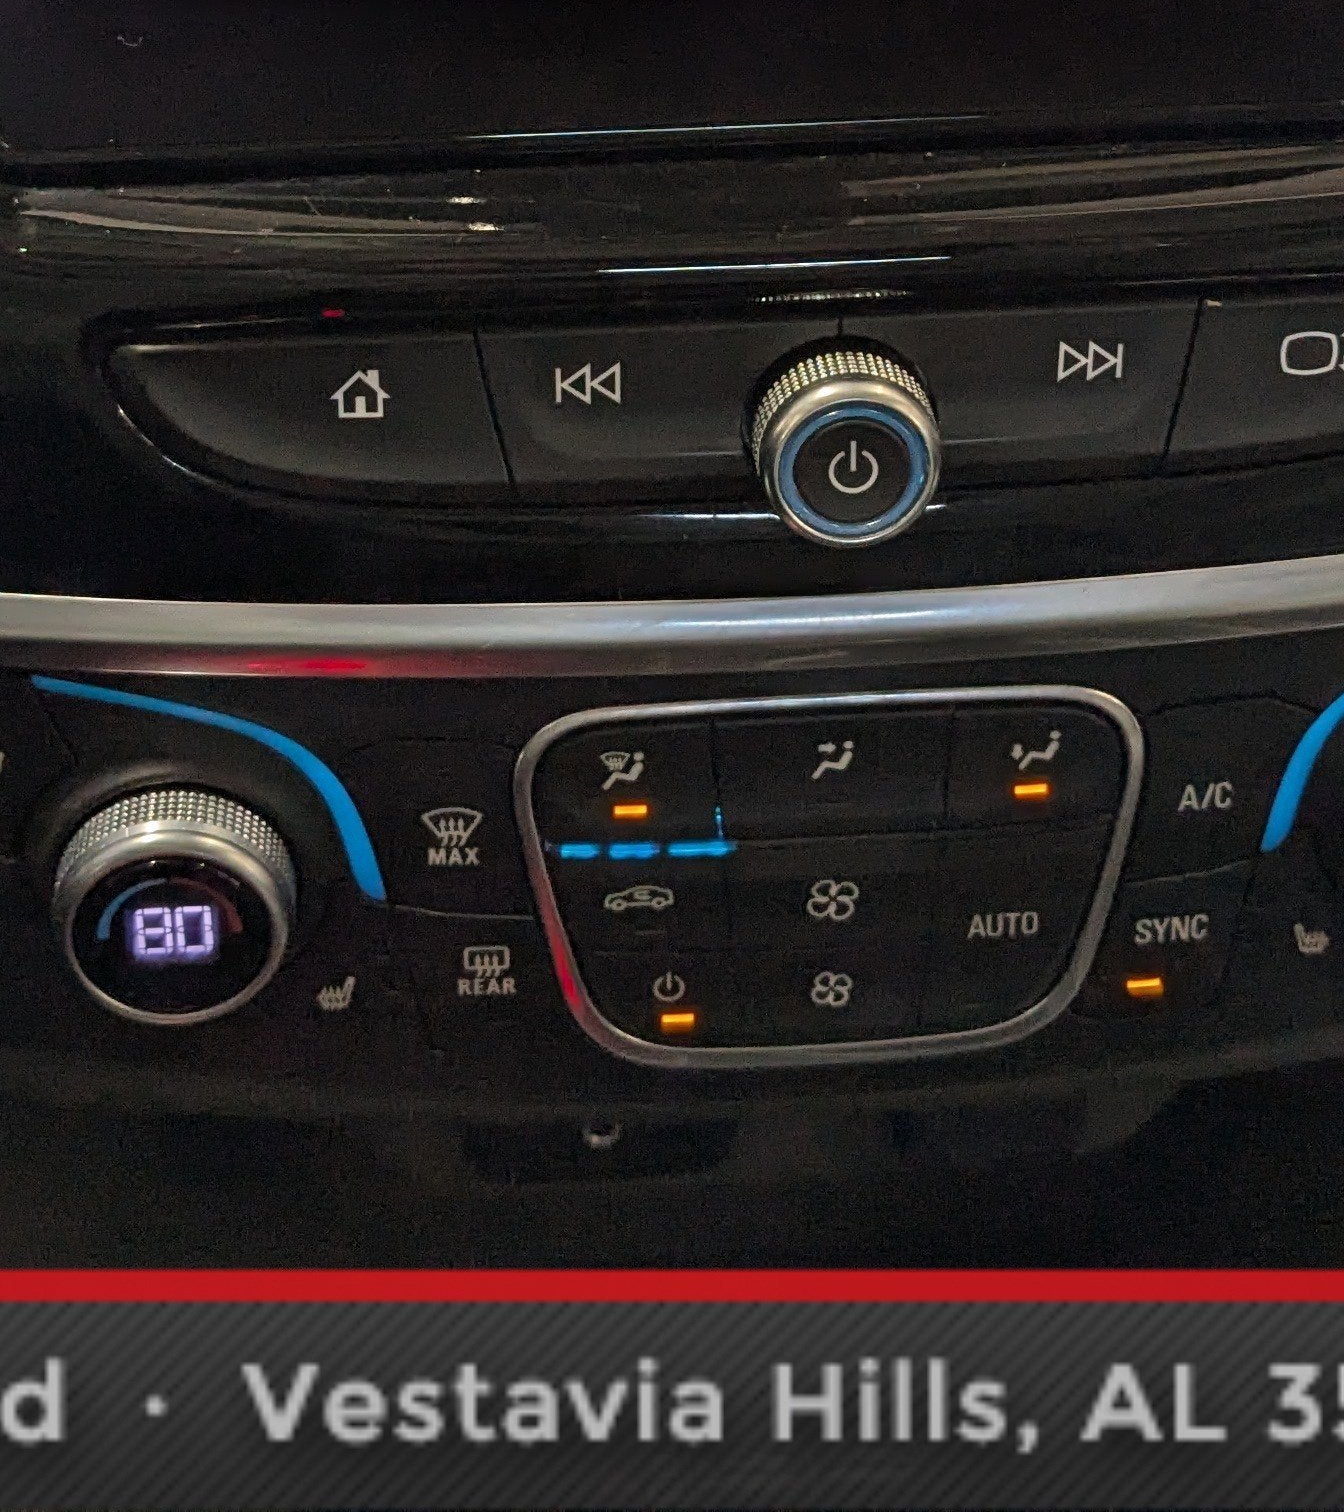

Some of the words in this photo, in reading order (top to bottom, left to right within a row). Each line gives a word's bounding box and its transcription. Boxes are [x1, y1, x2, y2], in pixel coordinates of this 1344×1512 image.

[1178, 781, 1233, 811] A/C
[427, 846, 480, 867] MAX
[133, 904, 214, 955] 80
[968, 911, 1039, 939] AUTO
[1135, 913, 1209, 944] SYNC
[458, 974, 516, 996] REAR
